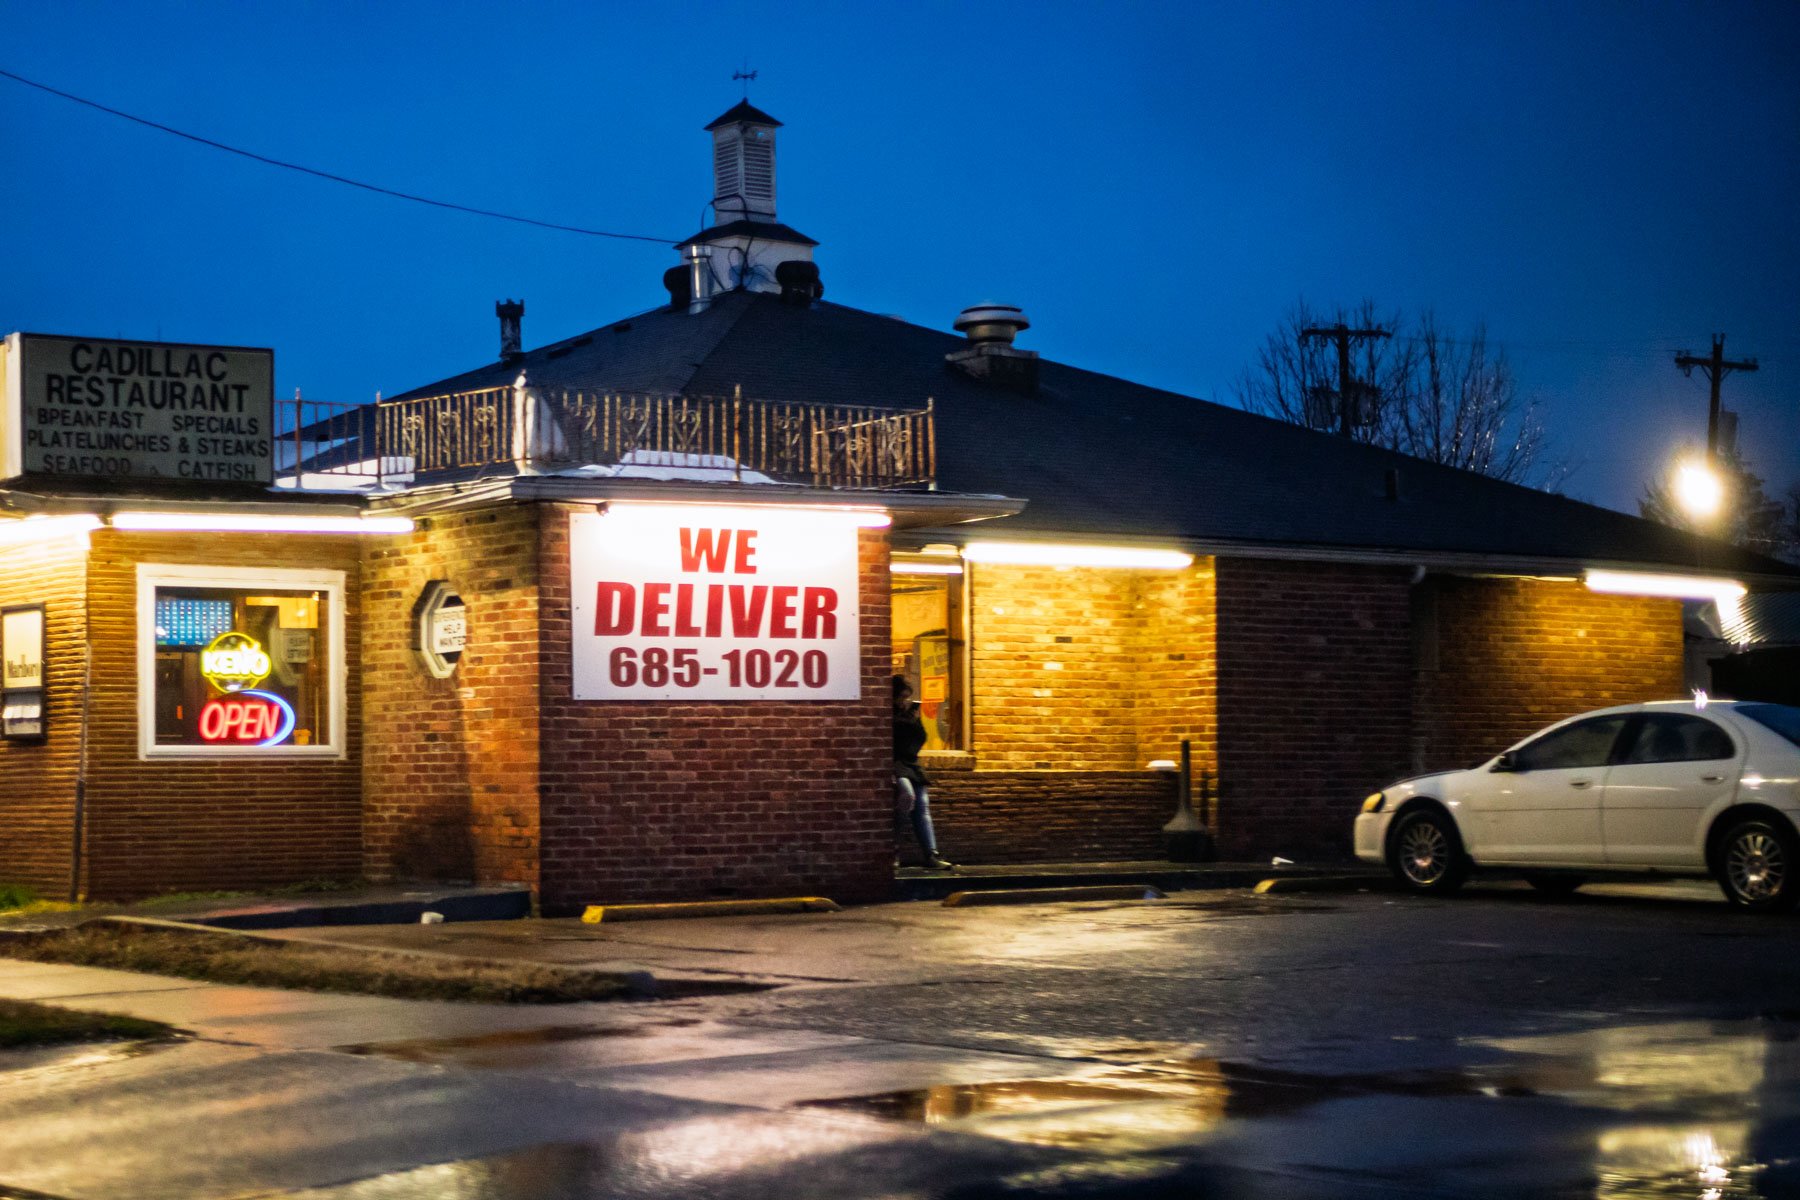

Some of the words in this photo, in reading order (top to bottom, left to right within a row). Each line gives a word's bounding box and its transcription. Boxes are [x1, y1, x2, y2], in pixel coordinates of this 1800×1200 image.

[71, 343, 228, 382] CADILLAC
[46, 374, 249, 412] RESTAURANT
[172, 415, 259, 435] SPECIALS
[178, 437, 190, 454] &
[197, 438, 269, 458] STEAKS
[43, 454, 132, 476] SEAFOOD
[178, 460, 256, 481] CATFISH
[679, 527, 758, 574] WE
[594, 581, 838, 640] DELIVER
[203, 648, 271, 677] KENO
[609, 646, 829, 688] 685-1020
[200, 701, 281, 740] OPEN
